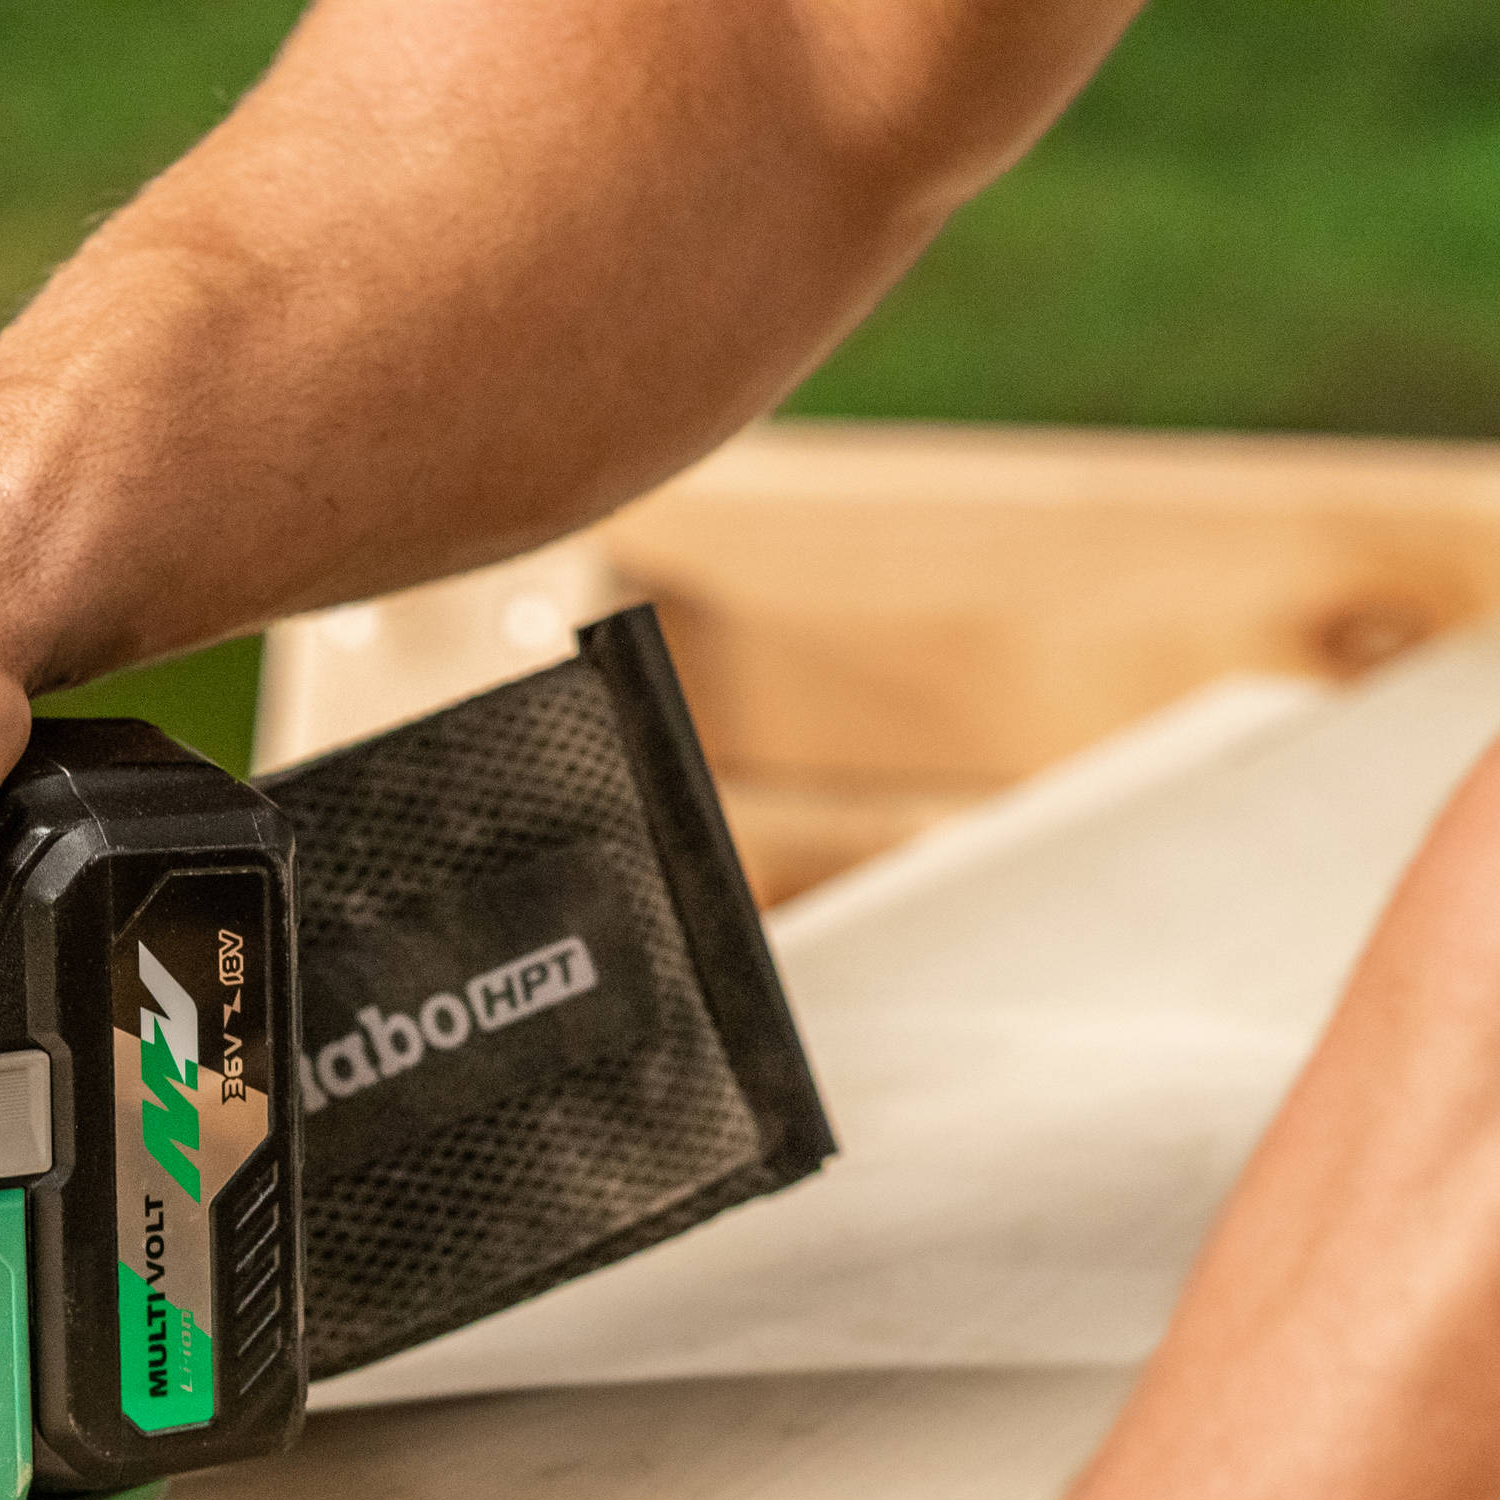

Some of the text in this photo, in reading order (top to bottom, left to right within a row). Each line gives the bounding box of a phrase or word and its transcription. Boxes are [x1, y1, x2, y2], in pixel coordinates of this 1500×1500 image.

[219, 928, 247, 1105] 36V 18V
[471, 940, 588, 1026] HPT
[144, 1194, 168, 1399] MULTI VOLT
[180, 1310, 194, 1393] Li-ion
